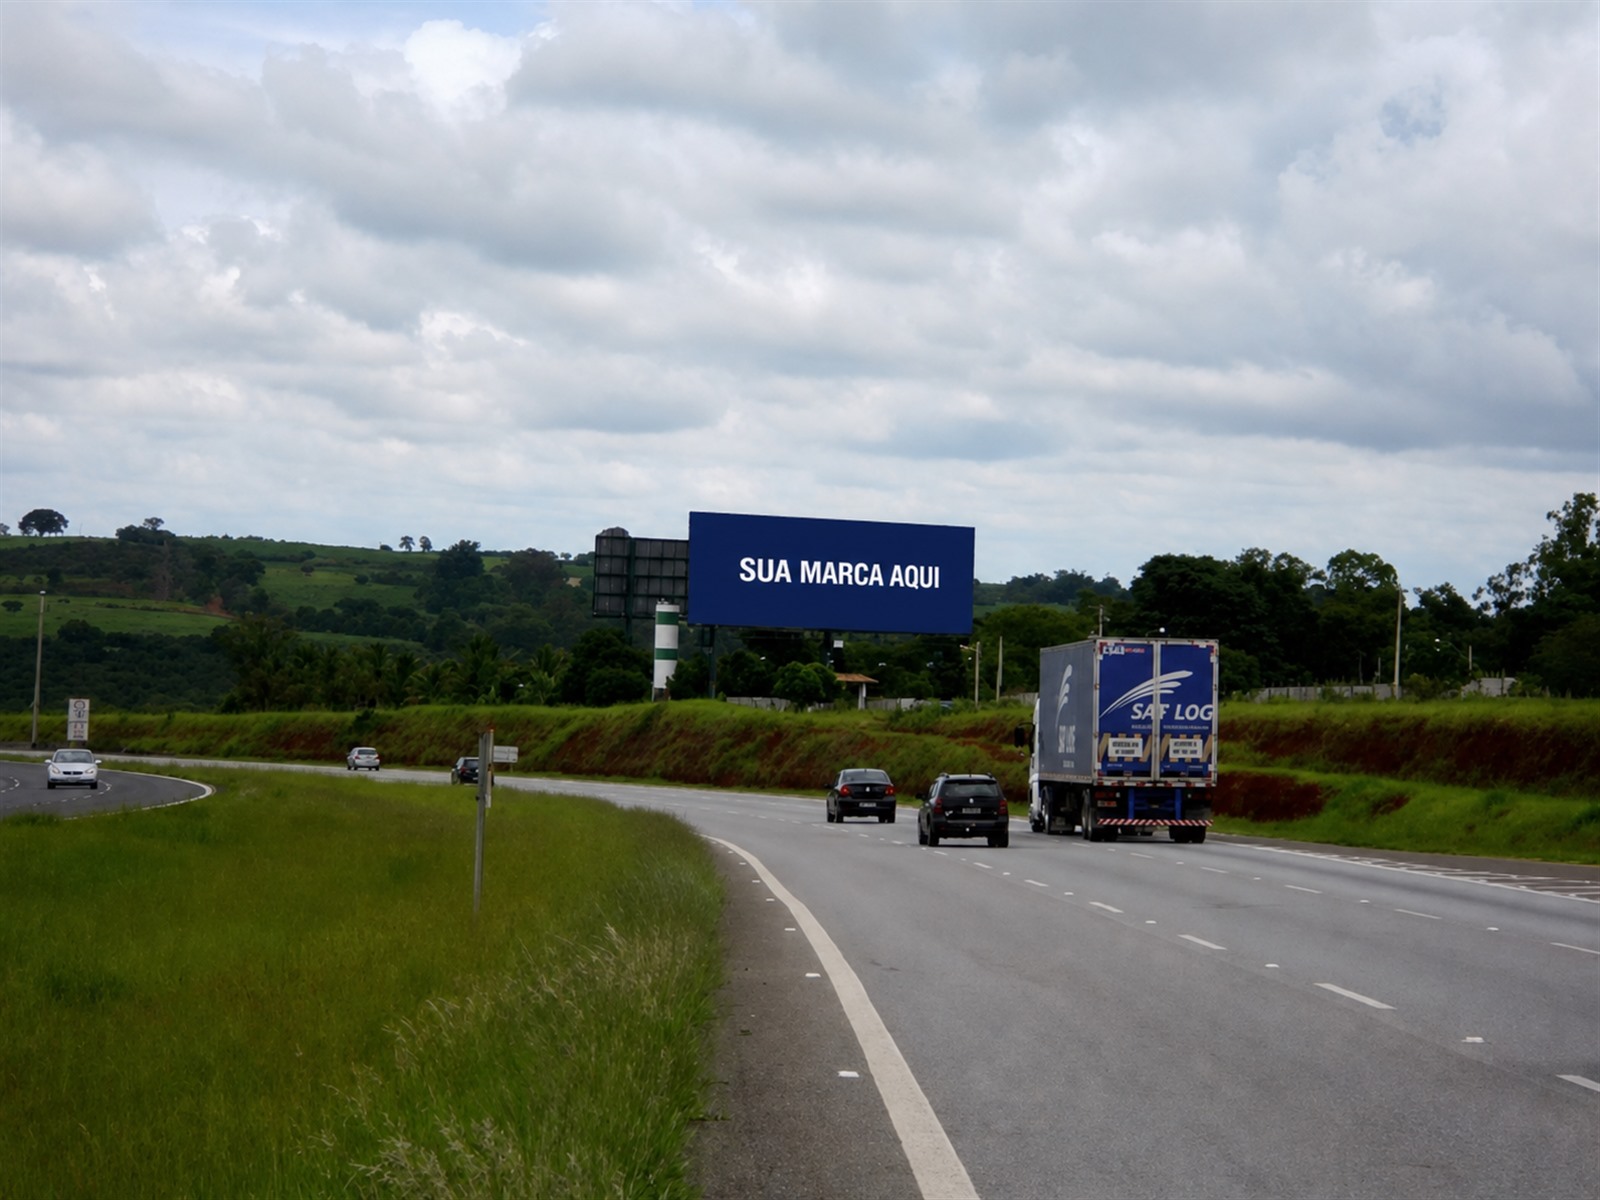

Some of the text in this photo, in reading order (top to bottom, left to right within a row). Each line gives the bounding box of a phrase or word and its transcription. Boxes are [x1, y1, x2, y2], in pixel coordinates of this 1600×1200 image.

[739, 557, 940, 589] SUA MARCA AQUI
[1174, 704, 1213, 721] LOG
